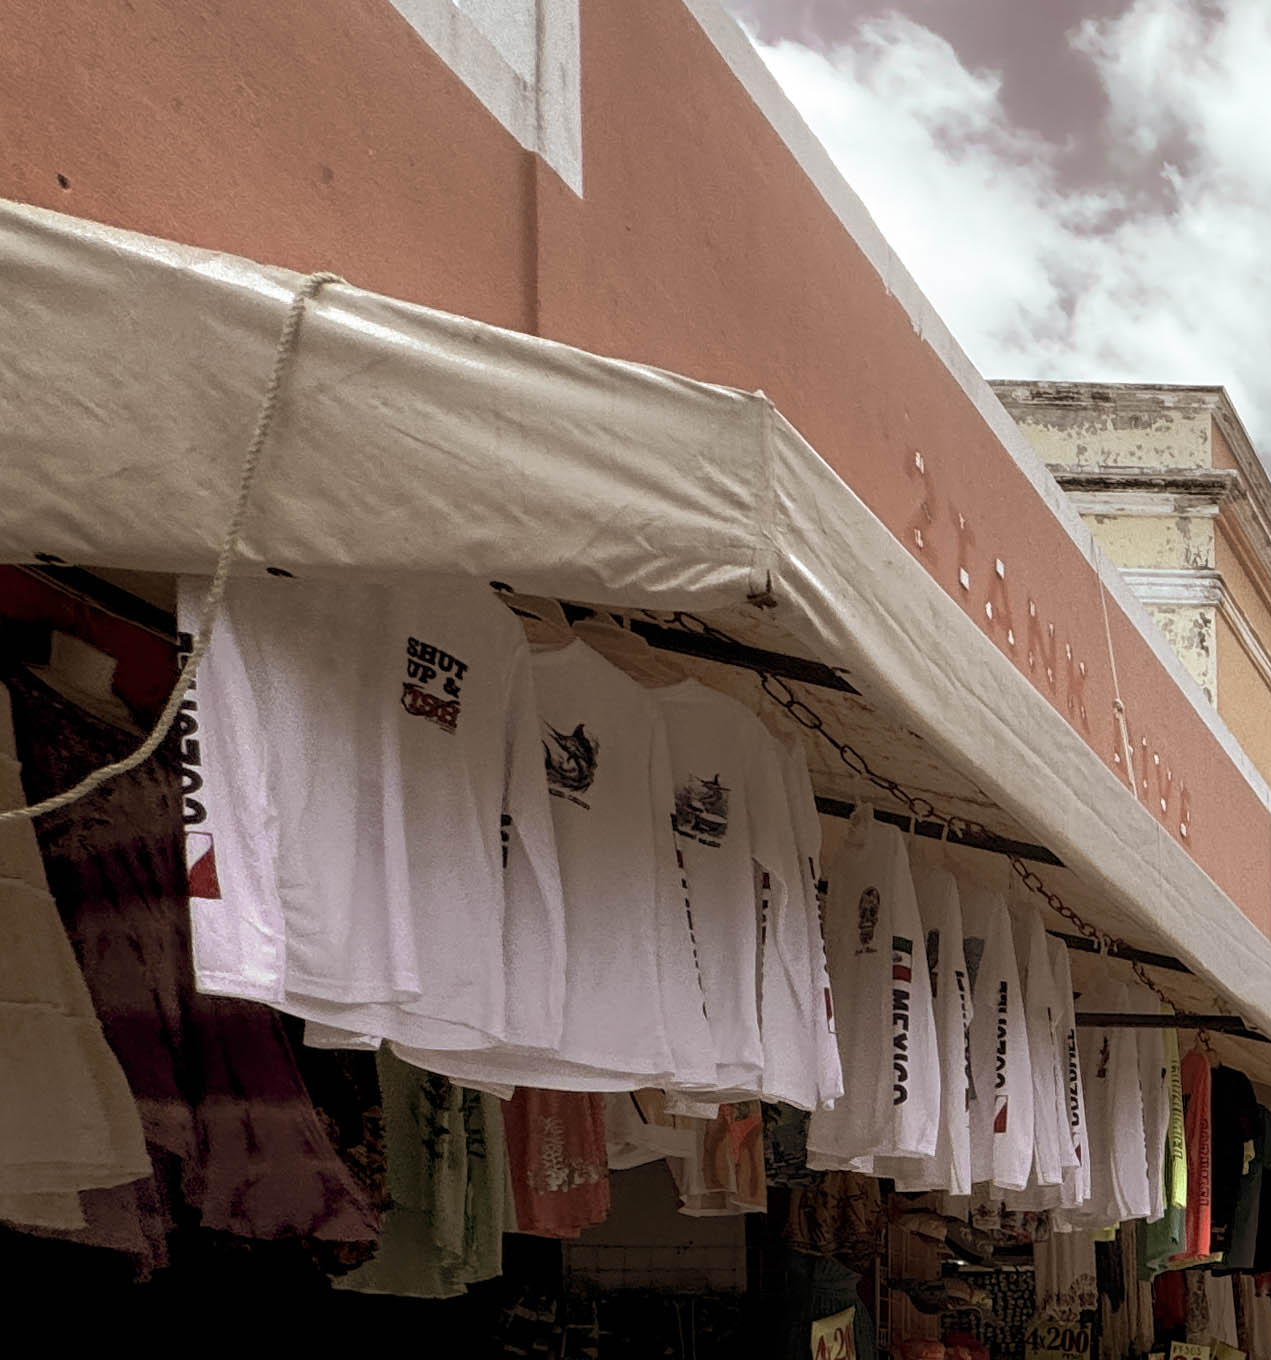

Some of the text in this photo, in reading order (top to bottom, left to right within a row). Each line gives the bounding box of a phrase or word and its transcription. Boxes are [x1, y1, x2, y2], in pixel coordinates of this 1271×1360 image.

[407, 636, 469, 681] SHUT
[407, 658, 461, 699] UP &
